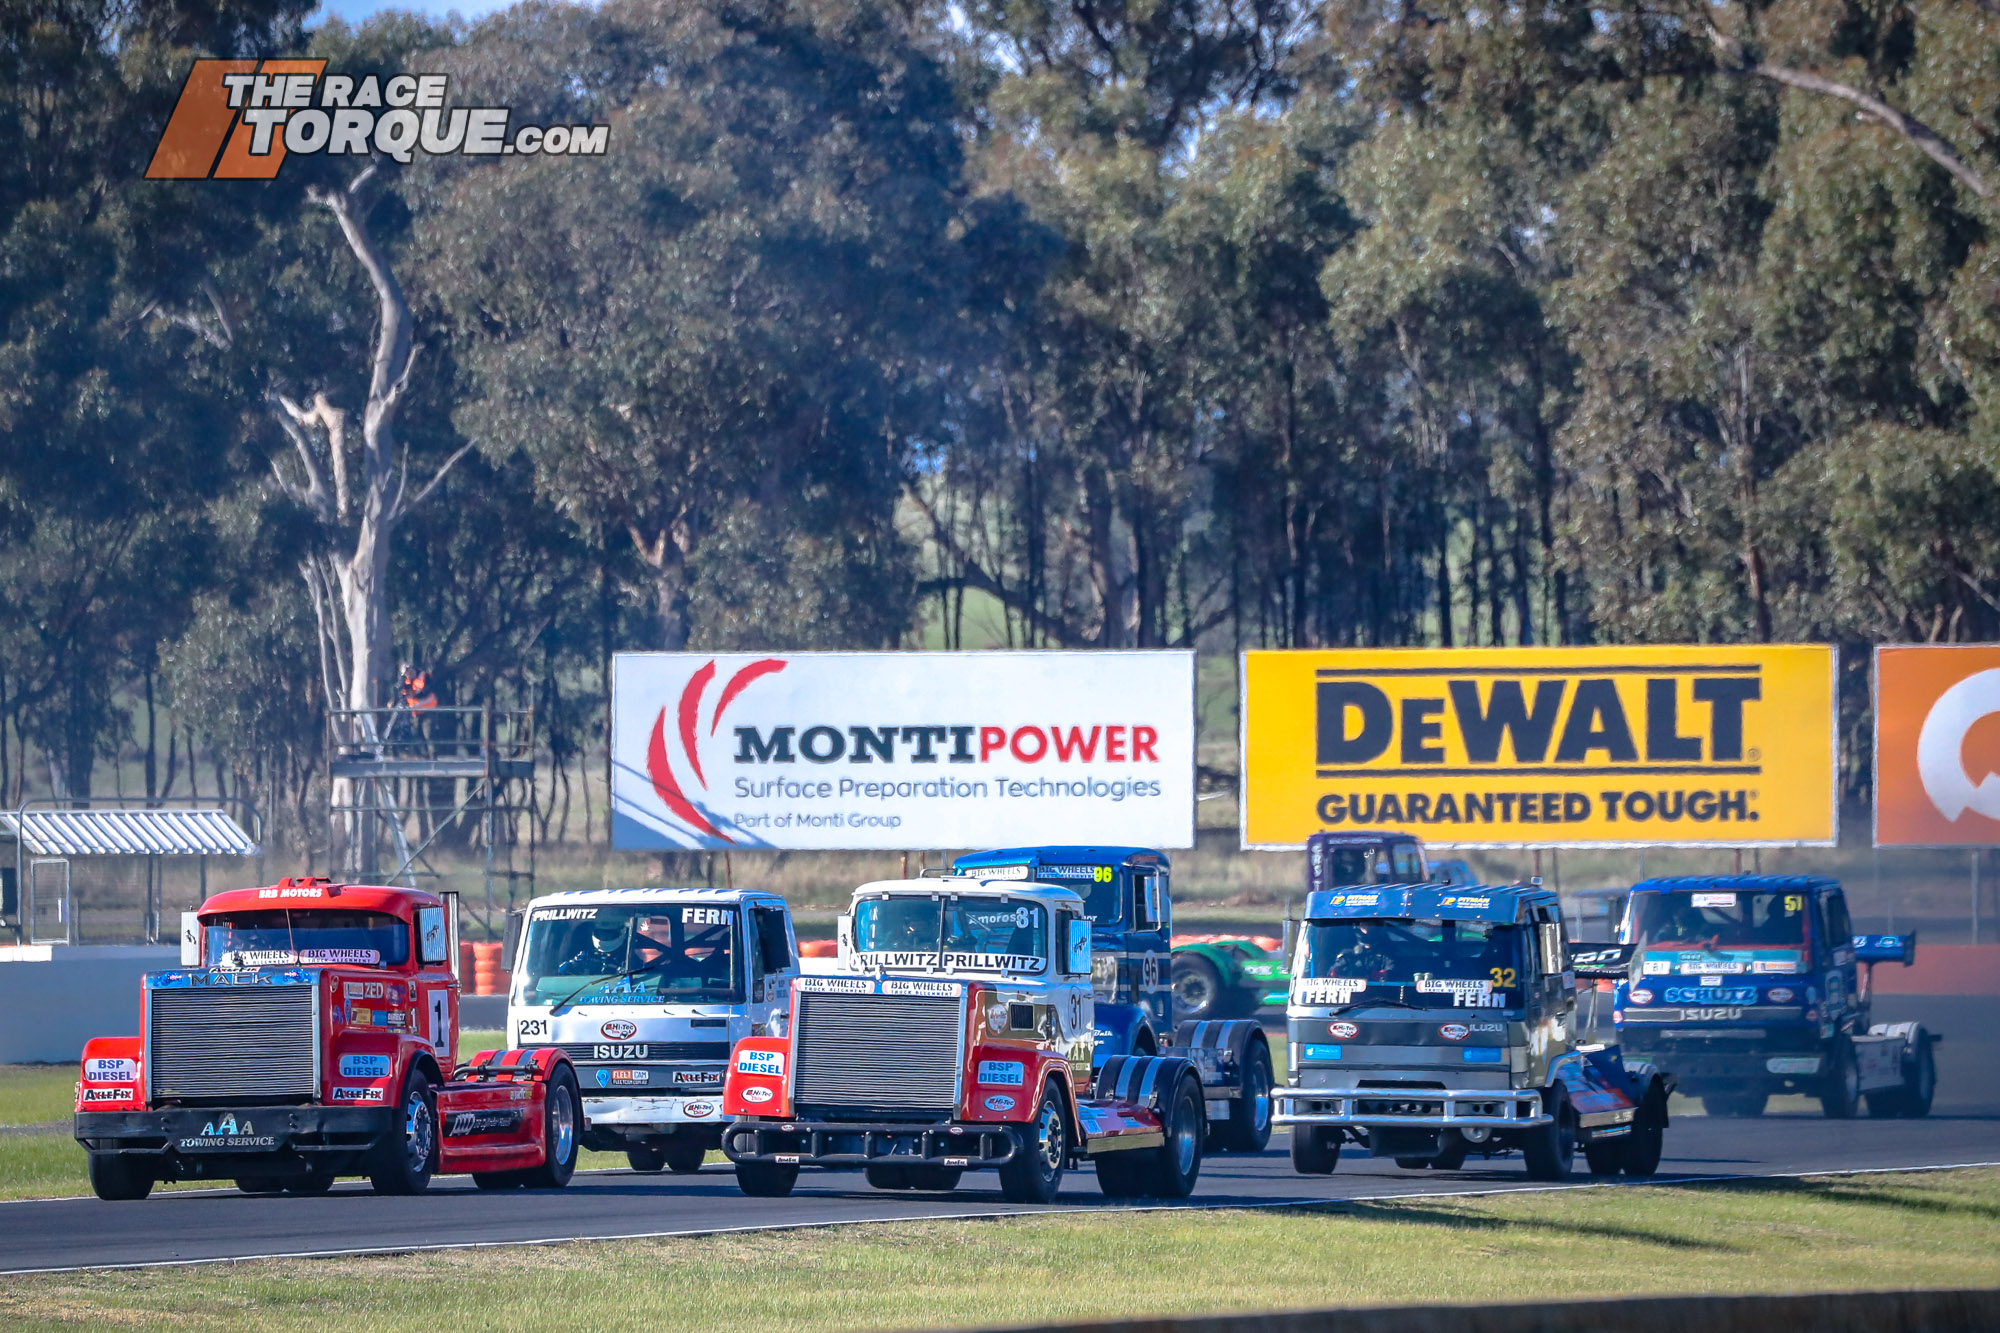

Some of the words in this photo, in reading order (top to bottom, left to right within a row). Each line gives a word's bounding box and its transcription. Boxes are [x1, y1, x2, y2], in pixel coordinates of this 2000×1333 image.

[733, 726, 1159, 763] MONTIPOWER
[735, 777, 832, 798] Surface
[839, 777, 987, 801] Preparation
[996, 776, 1161, 801] Technologies
[1317, 791, 1591, 824] GUARANTEED
[735, 813, 769, 828] Part
[773, 812, 793, 828] of
[797, 812, 844, 828] Monti
[848, 814, 901, 829] Group
[1038, 865, 1057, 873] BIG
[1058, 865, 1095, 873] WHEELS
[1093, 866, 1112, 883] 96
[258, 888, 278, 899] BRB
[280, 888, 322, 898] MOTORS
[533, 908, 598, 921] PRILLWITZ
[682, 908, 734, 925] FERN
[250, 951, 290, 959] WHEELS
[308, 950, 326, 958] BIG
[327, 950, 372, 958] WHEELS
[850, 953, 937, 966] RILLWITZ
[944, 954, 1040, 970] PRILLWITZ
[190, 974, 272, 986] MACK
[805, 979, 824, 987] BIG
[826, 979, 867, 989] WHEELS
[1322, 979, 1358, 987] WHEELS
[1490, 968, 1516, 988] 32
[598, 976, 646, 993] AAA
[891, 981, 910, 989] BIG
[912, 982, 953, 992] WHEELS
[1425, 980, 1442, 988] BIG
[1445, 980, 1484, 989] WHEELS
[579, 995, 619, 1004] TOWING
[620, 995, 665, 1004] SERVICE
[1304, 991, 1351, 1003] FERN
[1453, 993, 1506, 1008] FERN
[1071, 994, 1082, 1030] 31
[1680, 1007, 1743, 1021] ISUZU
[435, 1000, 444, 1048] 1
[521, 1020, 547, 1035] 231
[593, 1045, 648, 1059] ISUZU
[749, 1052, 774, 1061] BSP
[98, 1060, 124, 1069] BSP
[353, 1056, 377, 1064] BSP
[343, 1067, 386, 1076] DIESEL
[739, 1062, 782, 1074] DIESEL
[989, 1062, 1013, 1071] BSP
[88, 1071, 134, 1081] DIESEL
[612, 1071, 631, 1080] FLEET
[633, 1071, 647, 1079] CAM
[980, 1073, 1021, 1083] DIESEL
[201, 1113, 254, 1135] AAA
[180, 1138, 225, 1147] TOWING
[226, 1136, 275, 1147] SERVICE
